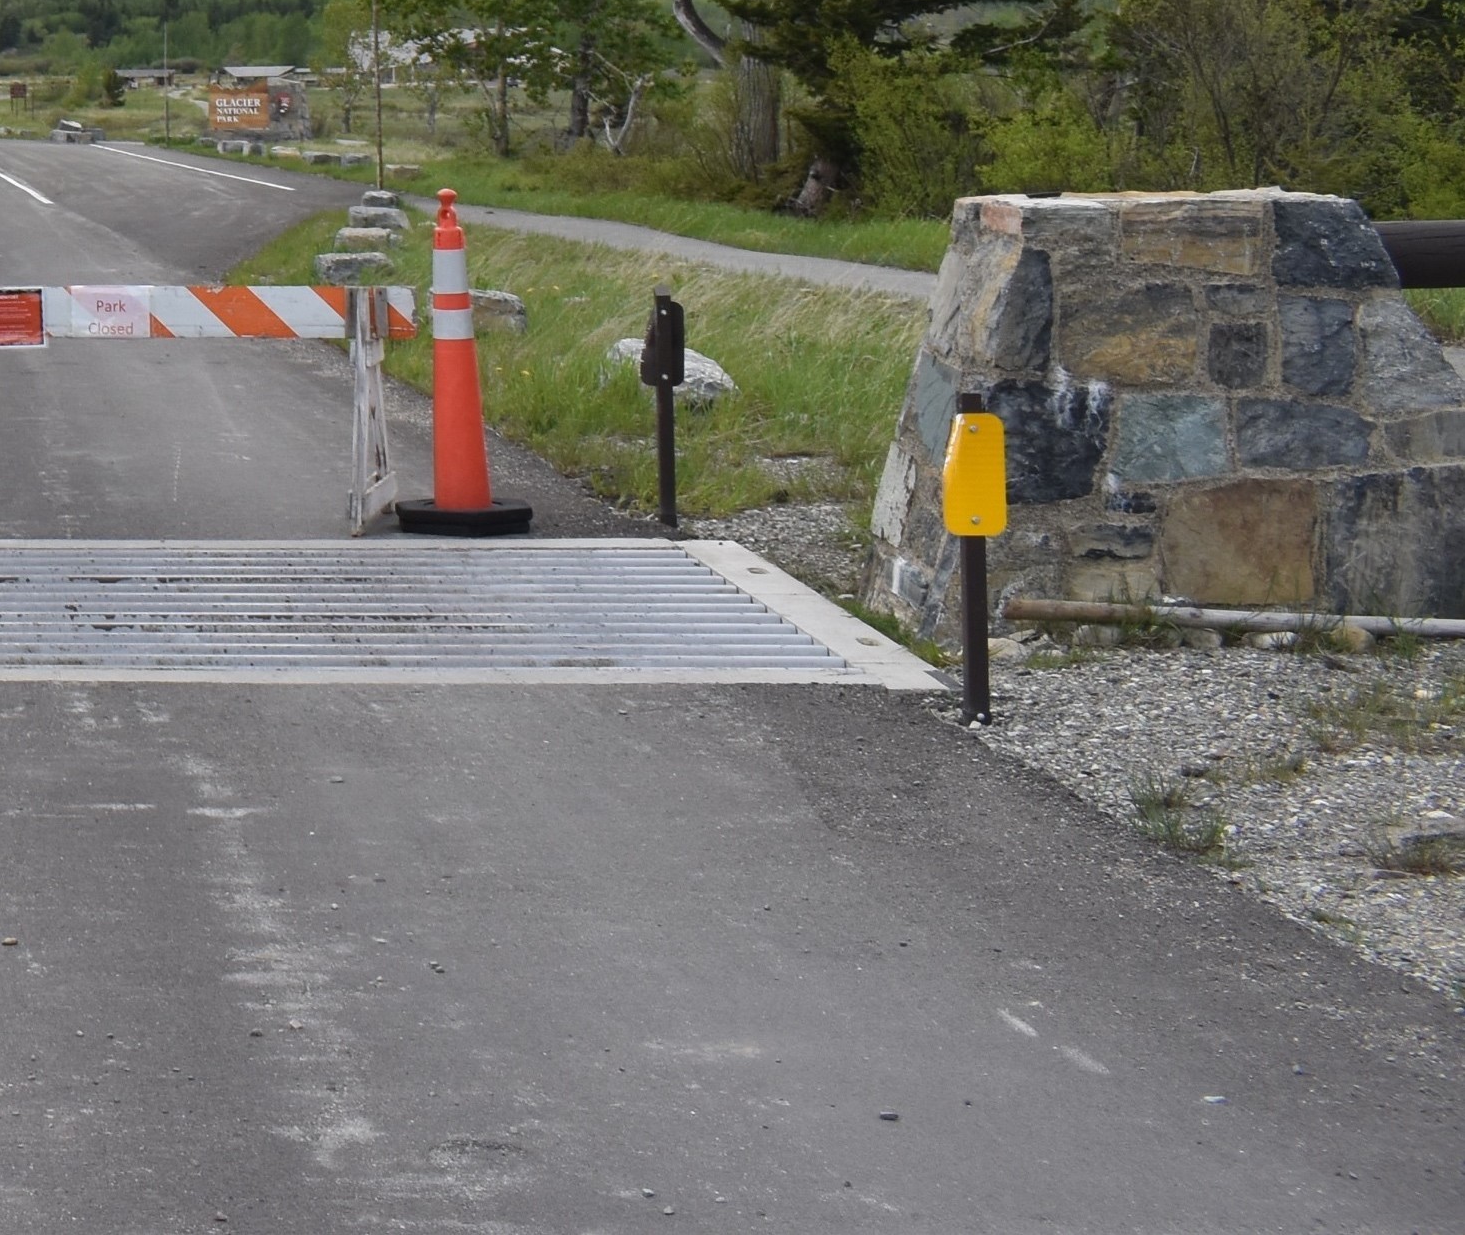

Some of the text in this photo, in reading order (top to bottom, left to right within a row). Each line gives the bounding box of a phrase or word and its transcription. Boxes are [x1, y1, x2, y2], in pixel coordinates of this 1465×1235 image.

[215, 98, 261, 107] GLACIER
[216, 107, 259, 115] NATIONAL
[216, 115, 239, 123] PARK
[96, 299, 126, 313] Park
[88, 321, 134, 335] Closed
